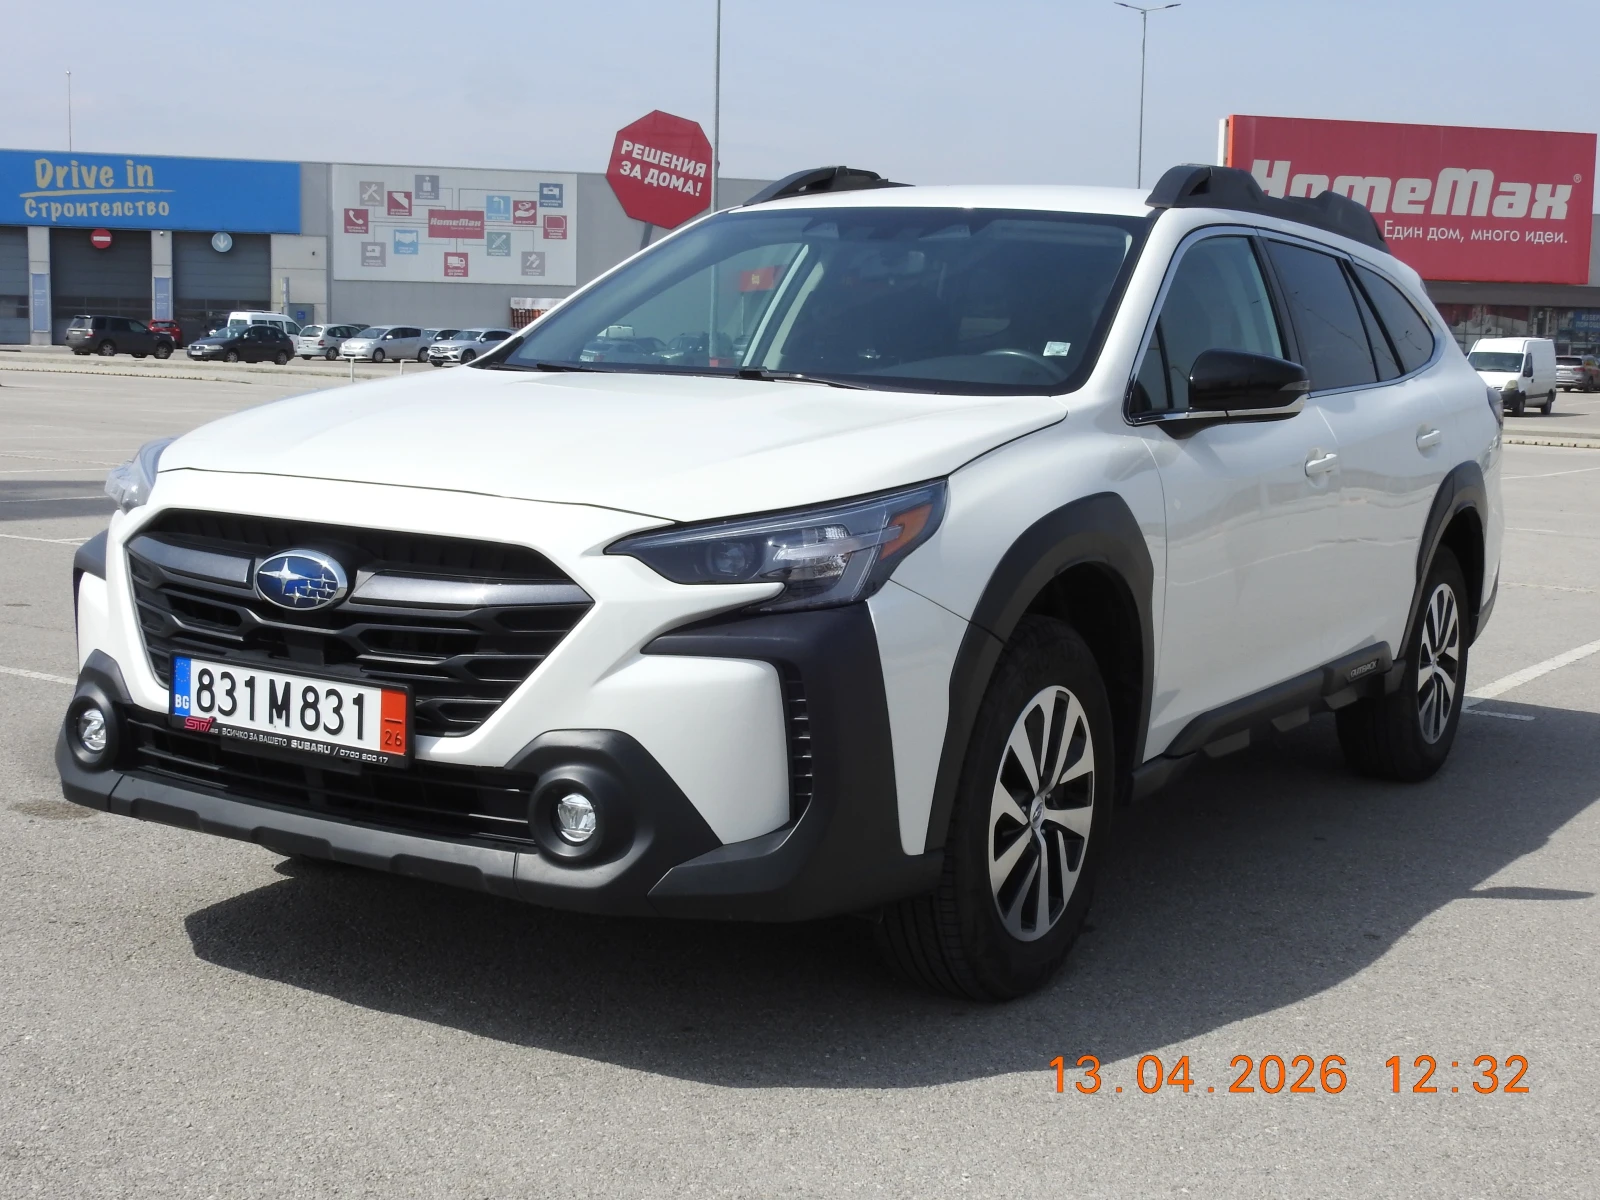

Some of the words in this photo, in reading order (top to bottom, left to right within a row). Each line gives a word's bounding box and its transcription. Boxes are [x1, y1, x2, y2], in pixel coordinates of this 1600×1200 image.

[620, 140, 707, 178] РЕШЕНИЯ
[35, 158, 115, 189] Drive
[126, 160, 154, 188] in
[619, 161, 642, 180] ЗА
[644, 168, 703, 197] ДОМА!
[1251, 159, 1573, 221] HomeMax
[24, 198, 170, 222] Строителство
[430, 217, 482, 227] HomeMax
[1384, 220, 1423, 240] Един
[1427, 226, 1465, 243] дом,
[1471, 228, 1520, 242] много
[1526, 231, 1568, 245] идеи.
[174, 693, 190, 710] BG
[221, 727, 249, 740] ВСИЧКО
[249, 733, 259, 743] ЗА
[258, 734, 288, 747] ВАШЕТО
[290, 739, 331, 755] SUBARU
[332, 746, 340, 757] /
[339, 749, 360, 759] 0700
[378, 755, 389, 765] 17
[384, 729, 403, 747] 26
